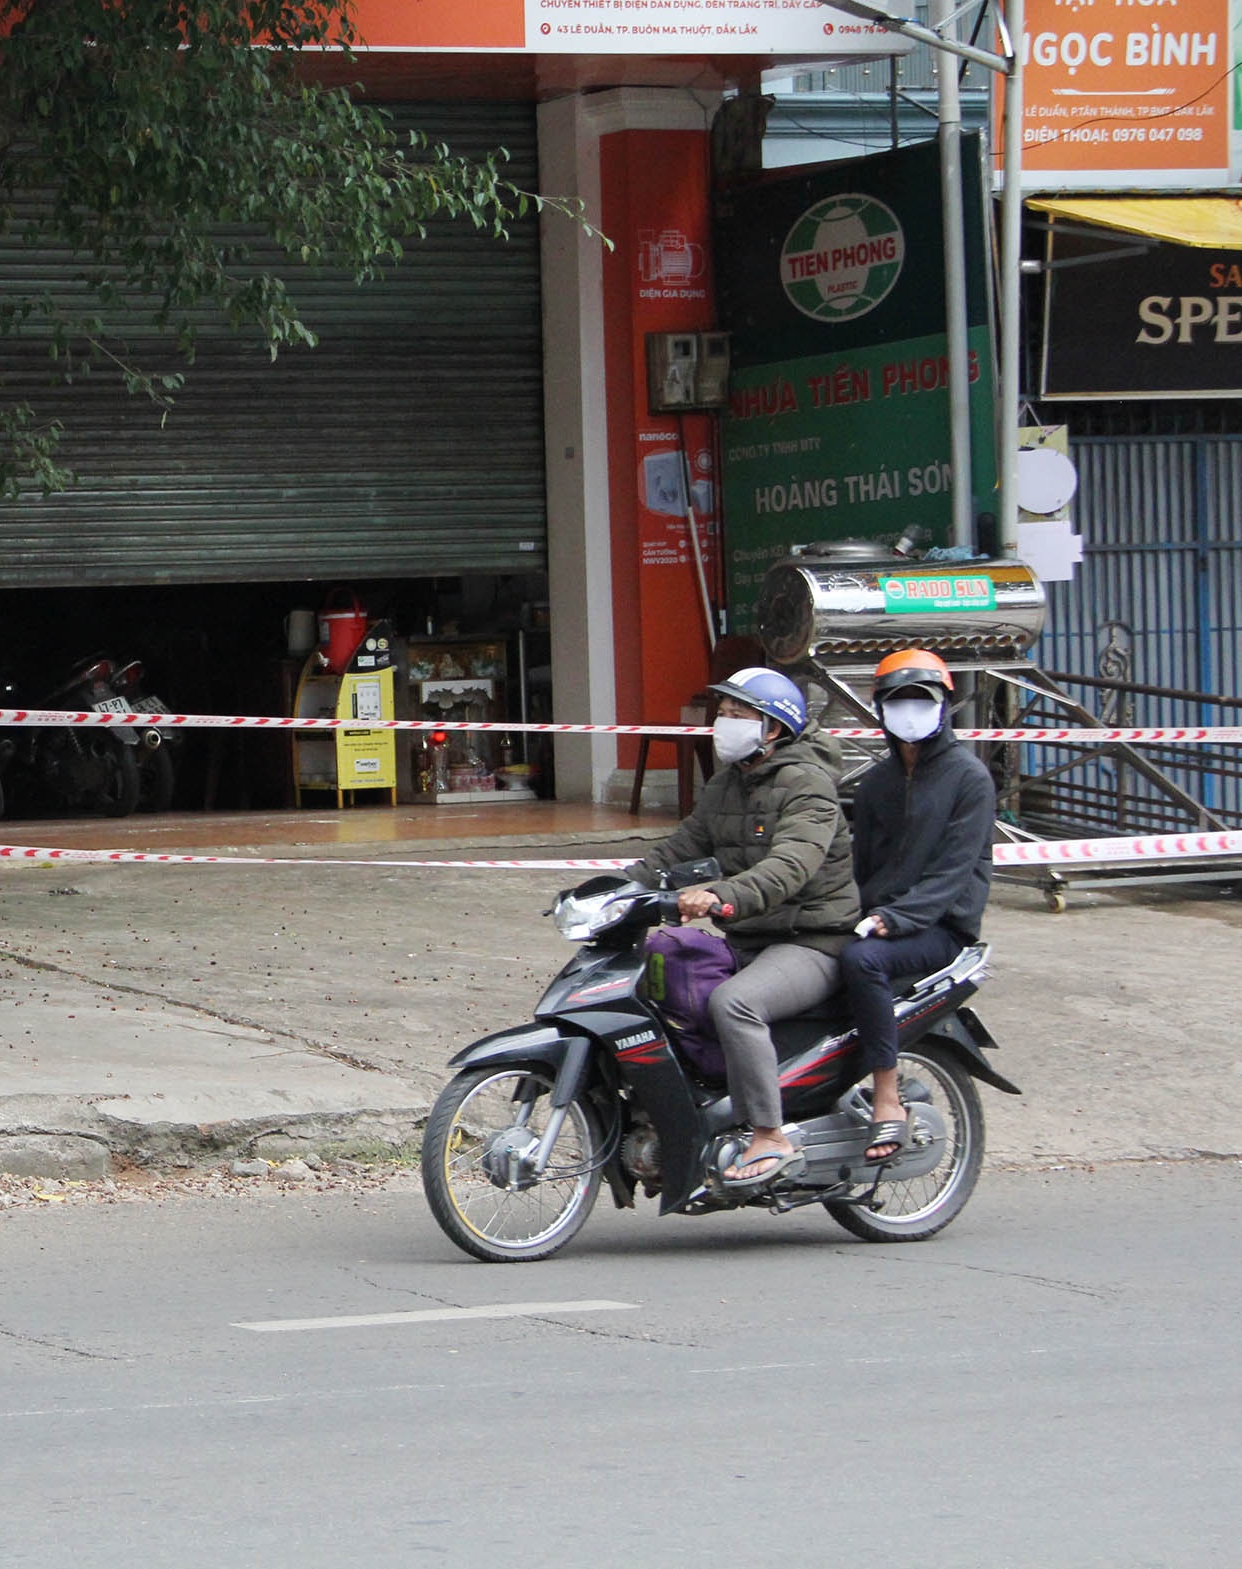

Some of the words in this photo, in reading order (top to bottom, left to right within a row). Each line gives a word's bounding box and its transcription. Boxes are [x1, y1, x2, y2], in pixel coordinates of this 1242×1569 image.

[727, 0, 761, 9] TRANG
[557, 25, 569, 34] 43
[571, 24, 582, 34] LÊ
[632, 25, 660, 35] BUÔN
[662, 26, 678, 35] MA
[1125, 23, 1217, 66] BÌNH
[1112, 127, 1147, 142] 0976
[1148, 127, 1175, 142] 047
[1177, 127, 1204, 142] 098
[832, 237, 896, 271] PHONG
[1209, 263, 1242, 288] SA
[662, 288, 679, 299] GIA
[1135, 295, 1242, 345] SPE
[756, 475, 838, 515] HOÀNG
[844, 464, 901, 504] THÁI
[908, 459, 955, 496] SƠN
[905, 579, 952, 598] RADO
[954, 578, 989, 597] SUN
[614, 1029, 657, 1050] YAMAHA
